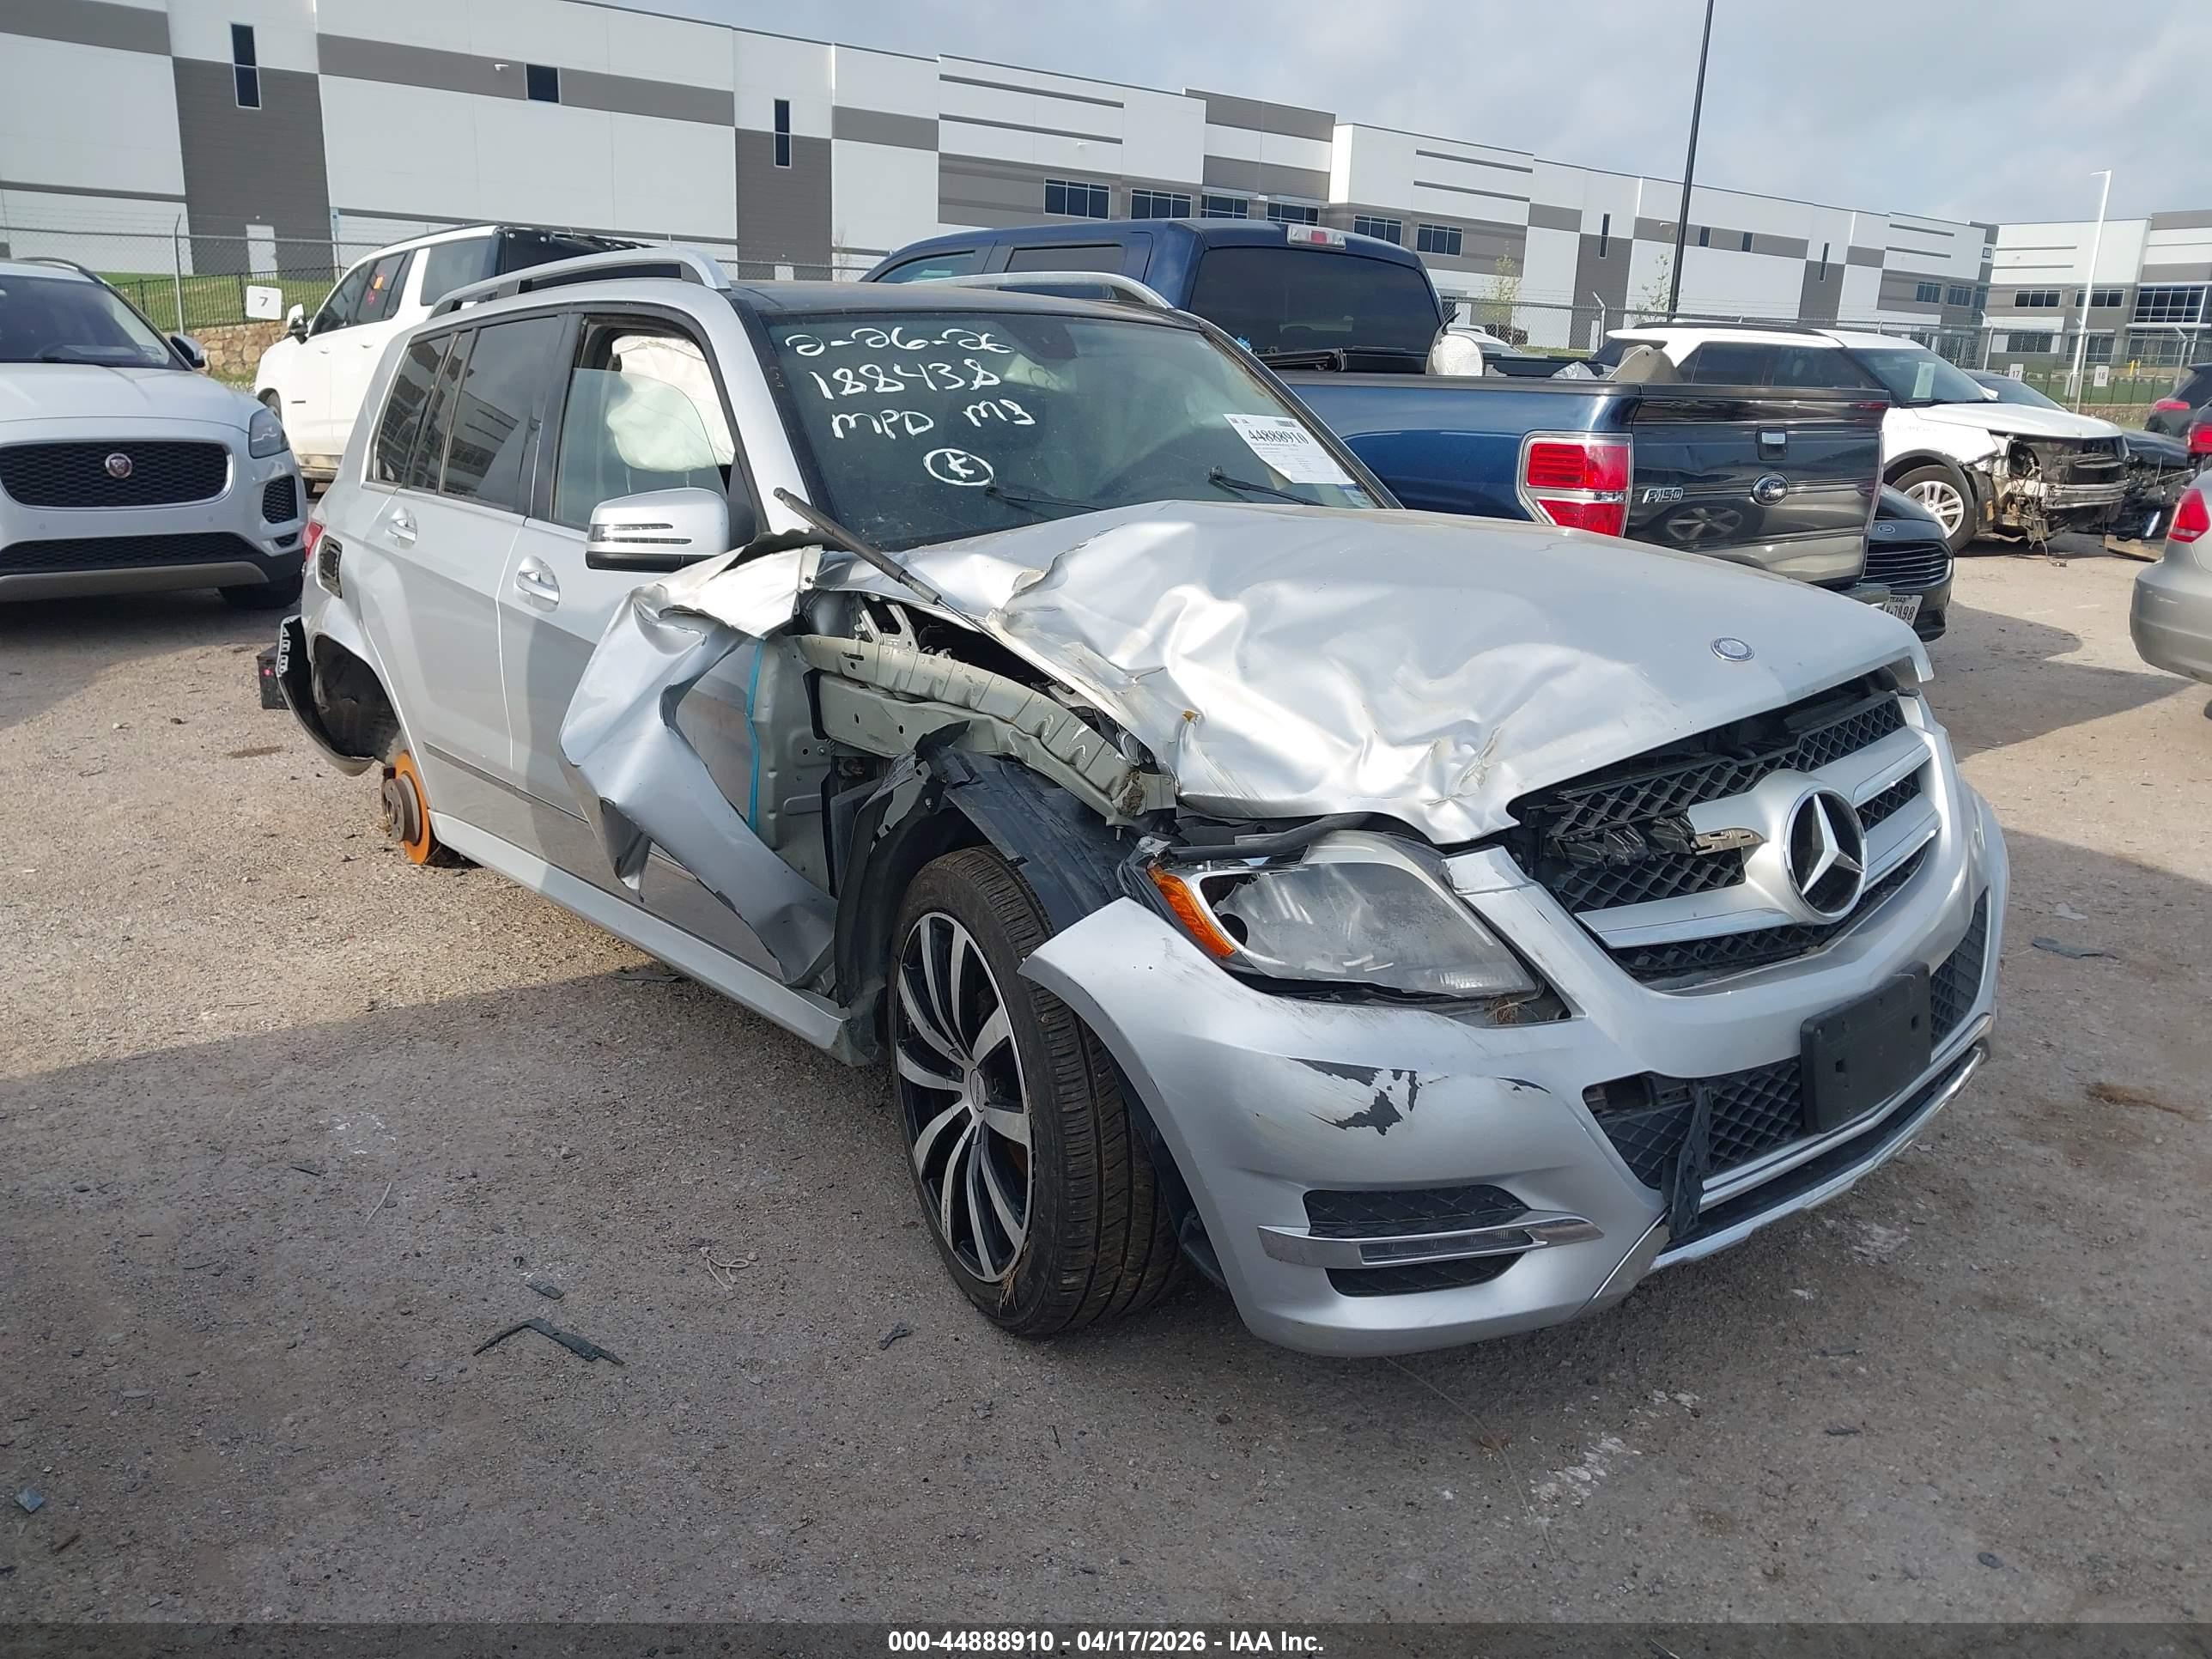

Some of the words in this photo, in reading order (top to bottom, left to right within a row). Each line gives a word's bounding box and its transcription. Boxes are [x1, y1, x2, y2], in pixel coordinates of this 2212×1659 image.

[259, 296, 269, 307] 7
[785, 326, 1016, 356] 2-26-26
[808, 358, 1001, 400] 188438
[831, 409, 935, 440] MPD
[1248, 429, 1310, 445] 44888910
[1765, 481, 1786, 498] Ford
